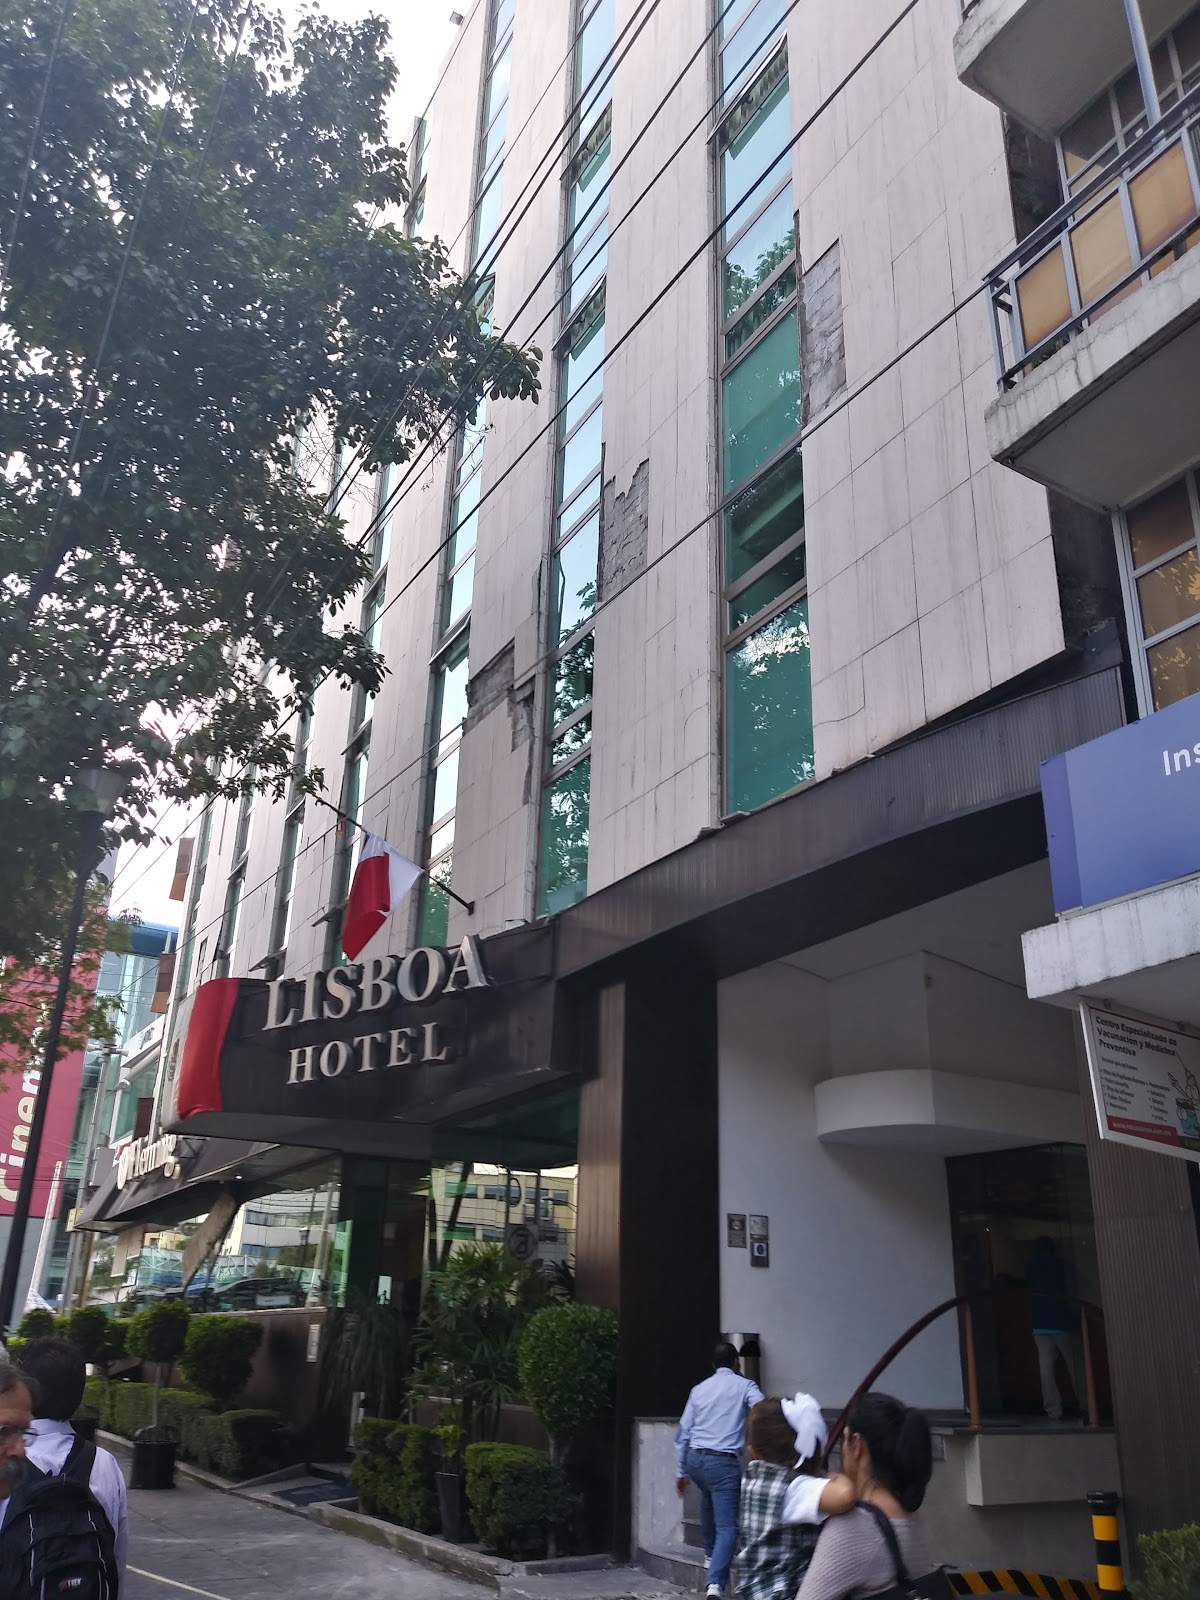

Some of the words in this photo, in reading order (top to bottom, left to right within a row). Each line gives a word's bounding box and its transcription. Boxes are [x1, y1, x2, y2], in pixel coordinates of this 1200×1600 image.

[261, 934, 491, 1031] LISBOA
[1095, 1016, 1120, 1030] Centro
[1121, 1022, 1168, 1043] Especializado
[1168, 1036, 1177, 1046] de
[286, 1022, 449, 1085] HOTEL
[1099, 1038, 1137, 1057] Preventiva
[1144, 1041, 1176, 1056] Medicina
